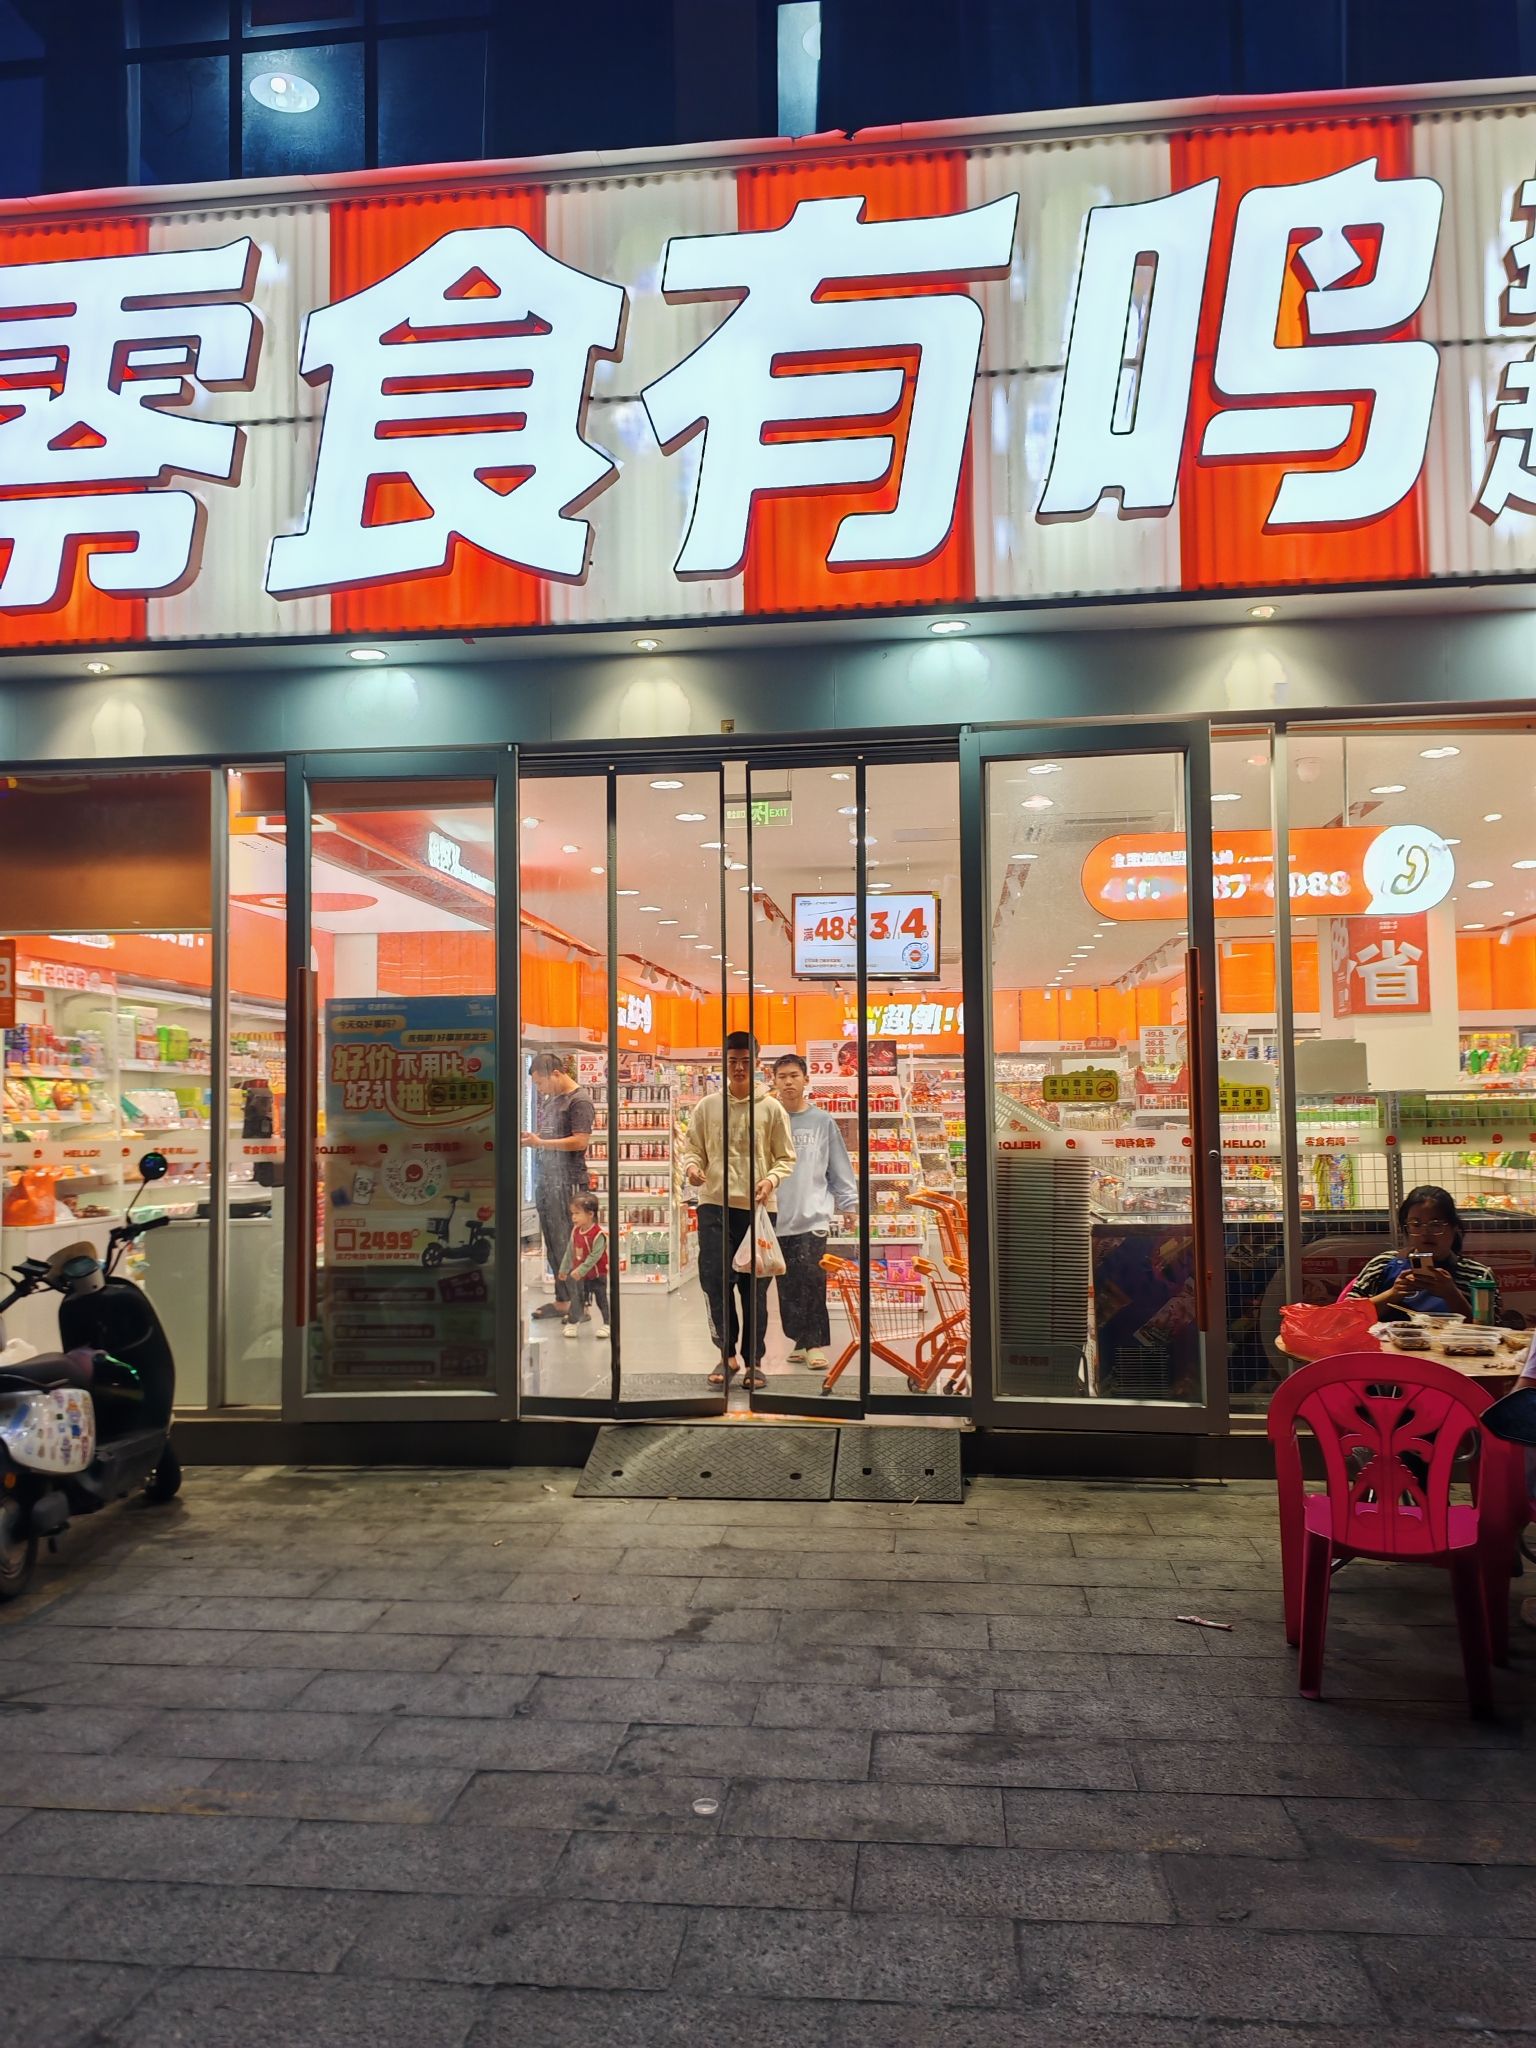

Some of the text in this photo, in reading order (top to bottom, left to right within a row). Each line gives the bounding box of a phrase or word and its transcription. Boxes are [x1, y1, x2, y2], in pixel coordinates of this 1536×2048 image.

[769, 808, 788, 817] EXIT
[814, 916, 844, 941] 48
[1355, 940, 1423, 1006] 省
[334, 1045, 462, 1081] 好价不用比
[811, 1063, 833, 1075] 9.9
[1223, 1139, 1266, 1149] HELLO!
[1305, 1136, 1346, 1147] 零食有鸣
[1422, 1136, 1467, 1145] HELLO!
[359, 1231, 413, 1250] 2499
